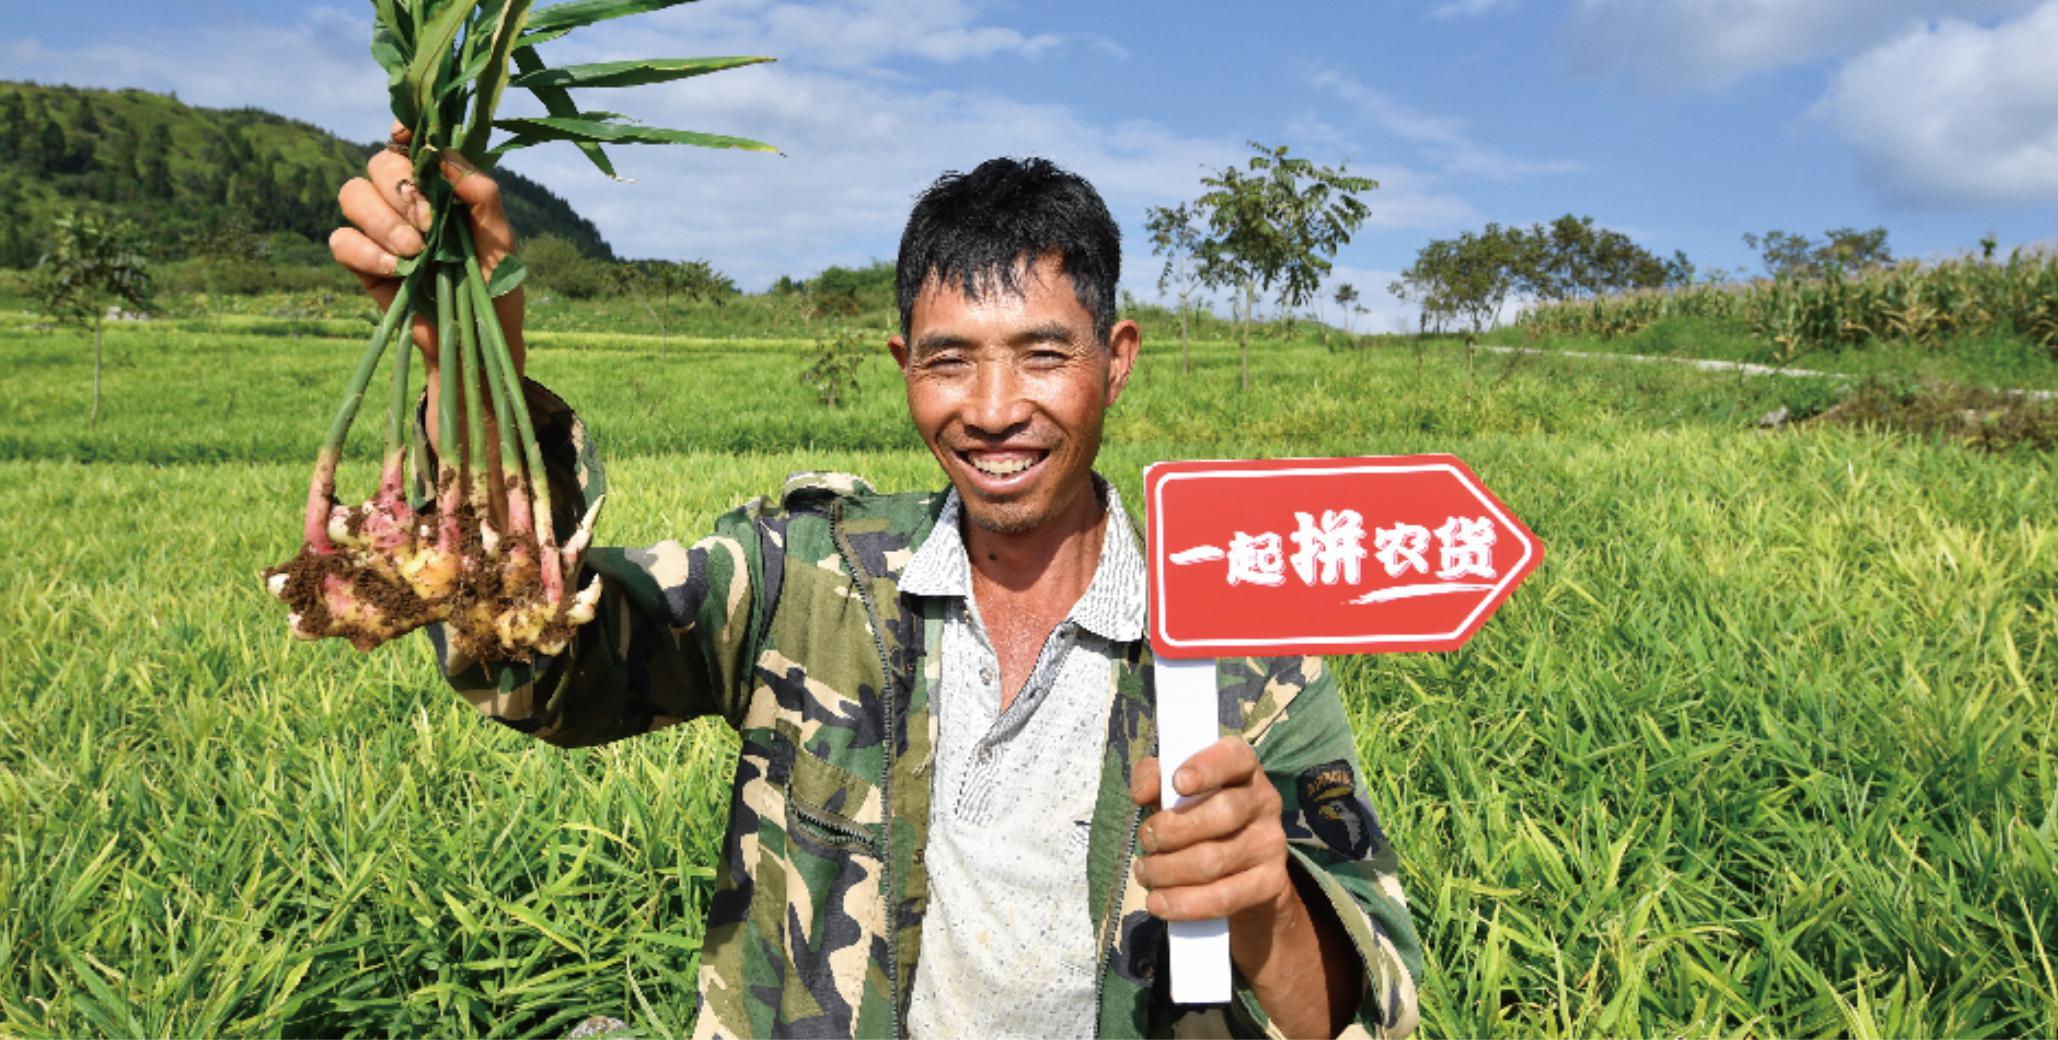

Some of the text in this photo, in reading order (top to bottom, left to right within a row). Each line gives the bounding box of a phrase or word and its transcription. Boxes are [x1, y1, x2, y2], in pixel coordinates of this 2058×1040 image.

[1168, 509, 1497, 587] 一起拼农货
